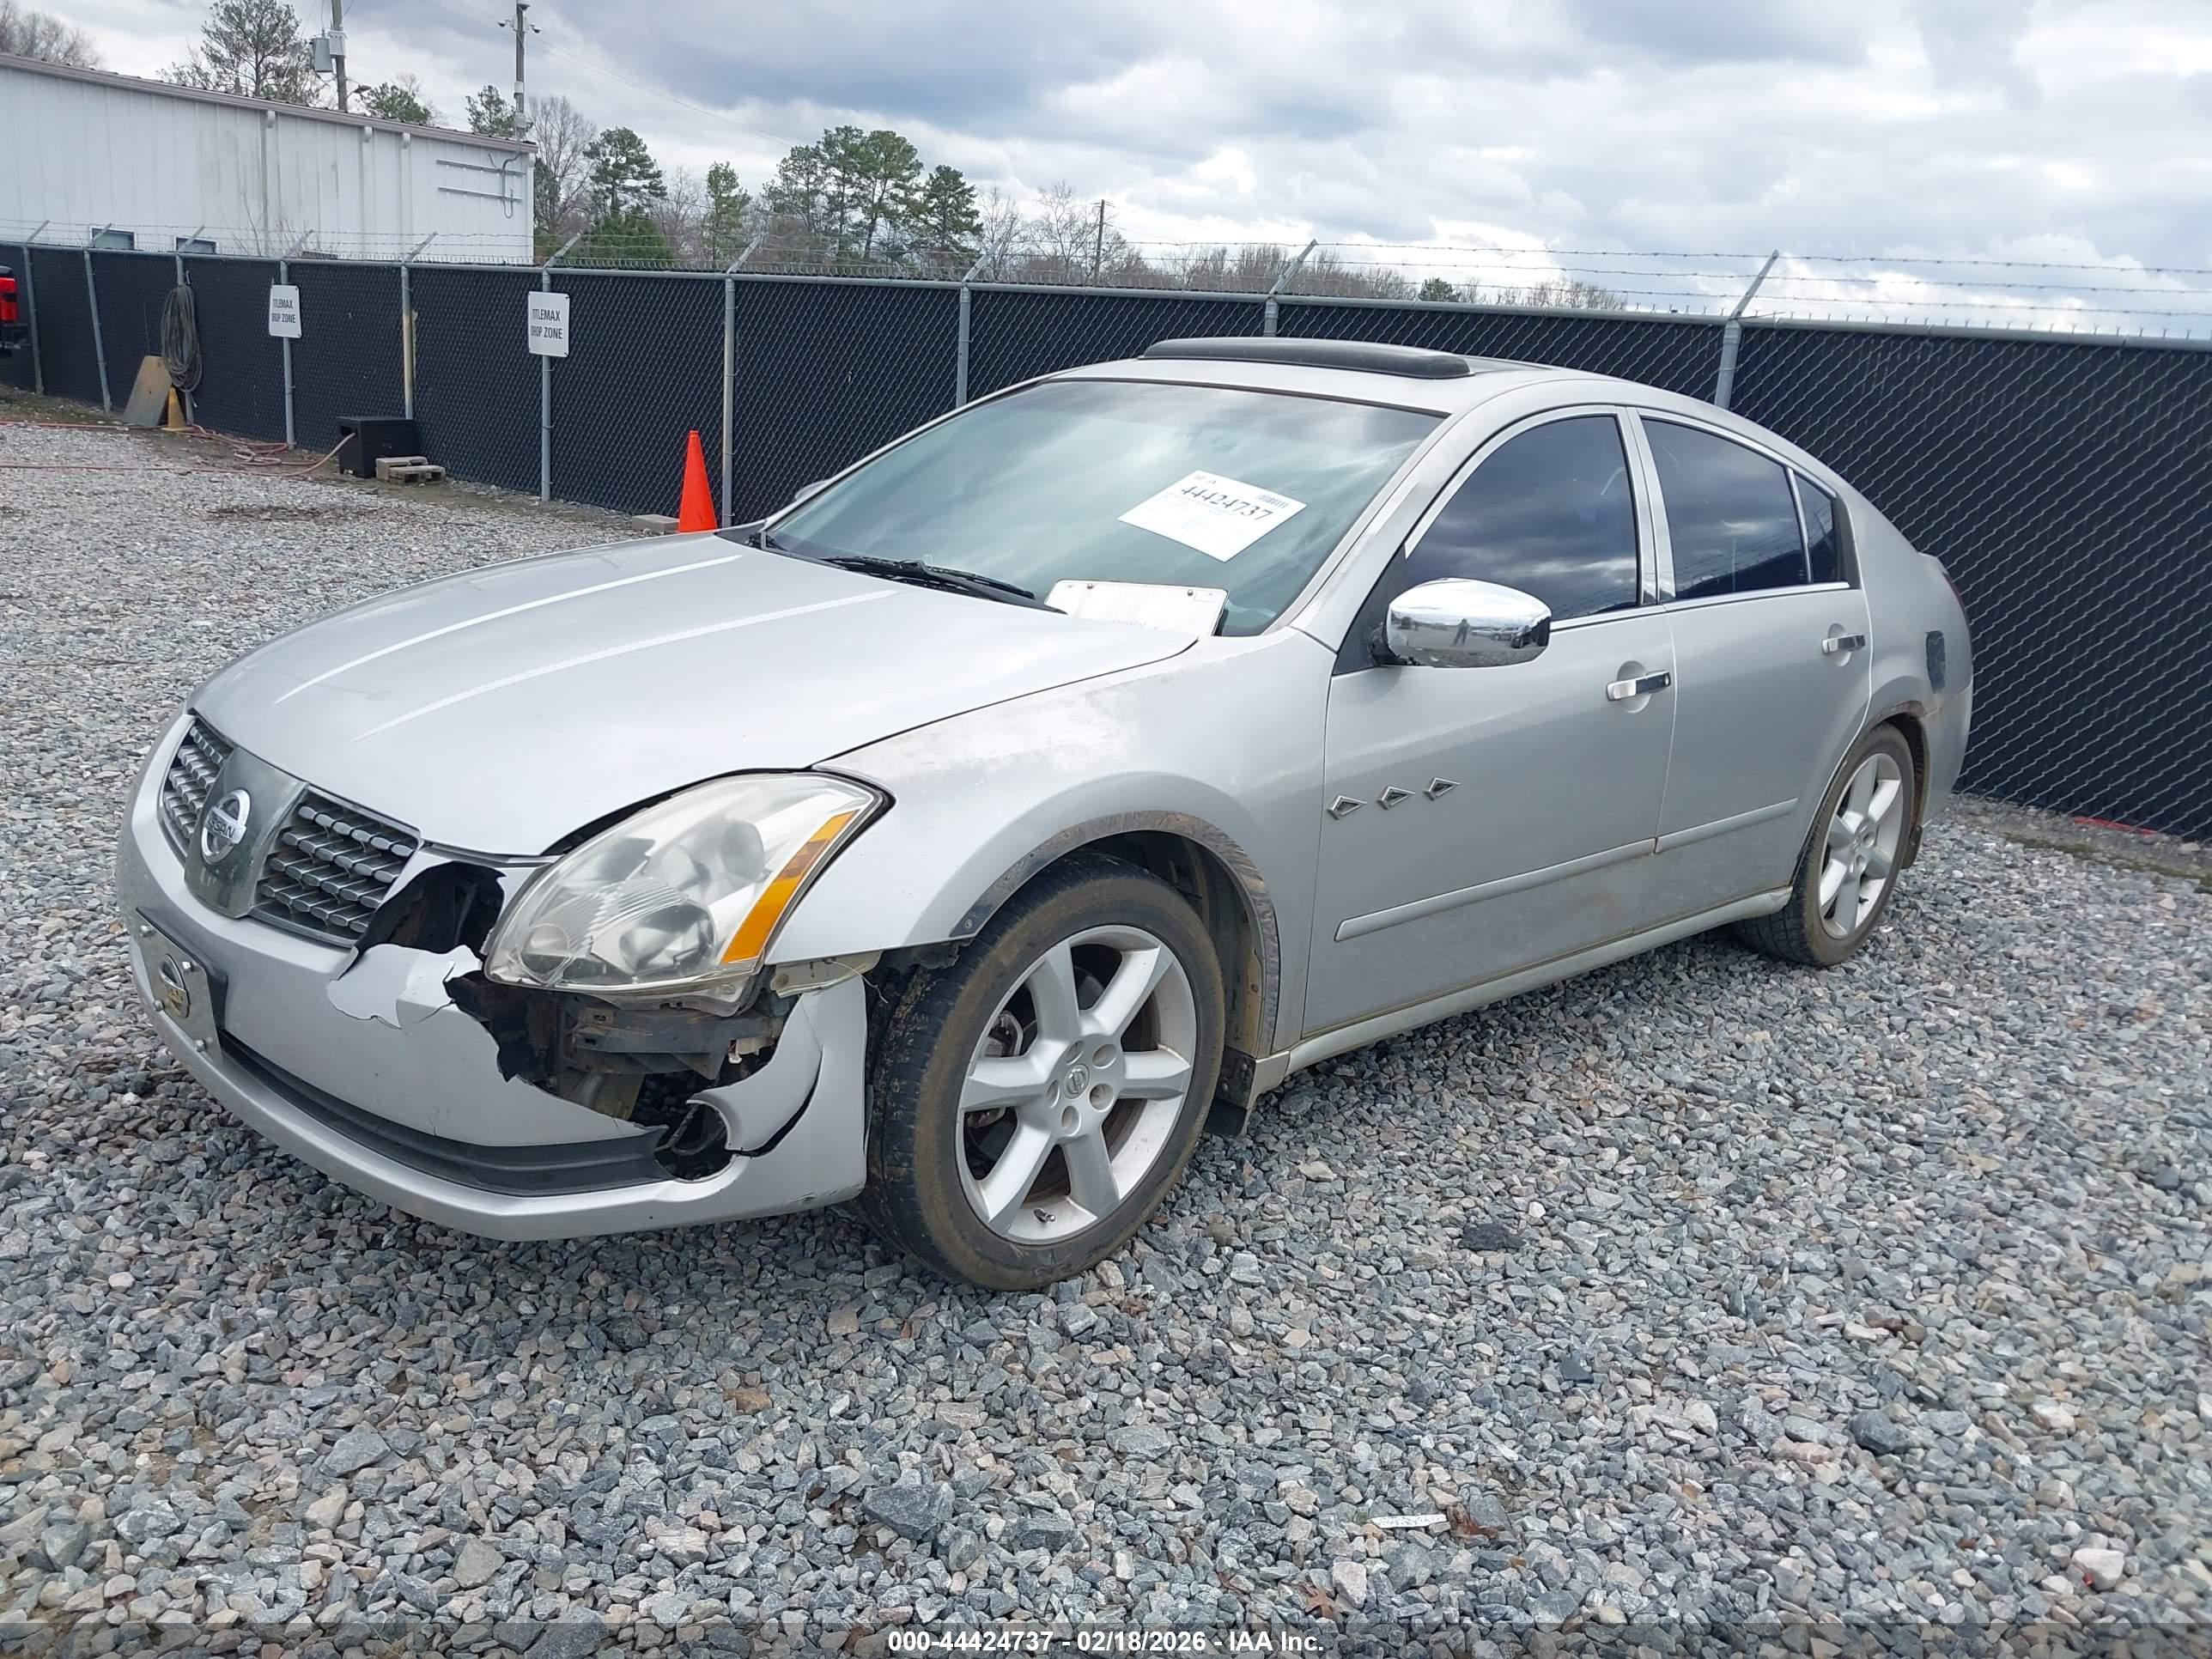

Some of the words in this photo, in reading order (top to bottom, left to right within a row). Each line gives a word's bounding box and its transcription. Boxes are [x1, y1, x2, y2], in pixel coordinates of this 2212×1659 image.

[281, 313, 296, 324] ZONE
[544, 326, 563, 340] ZONE
[1181, 486, 1274, 520] 44424737
